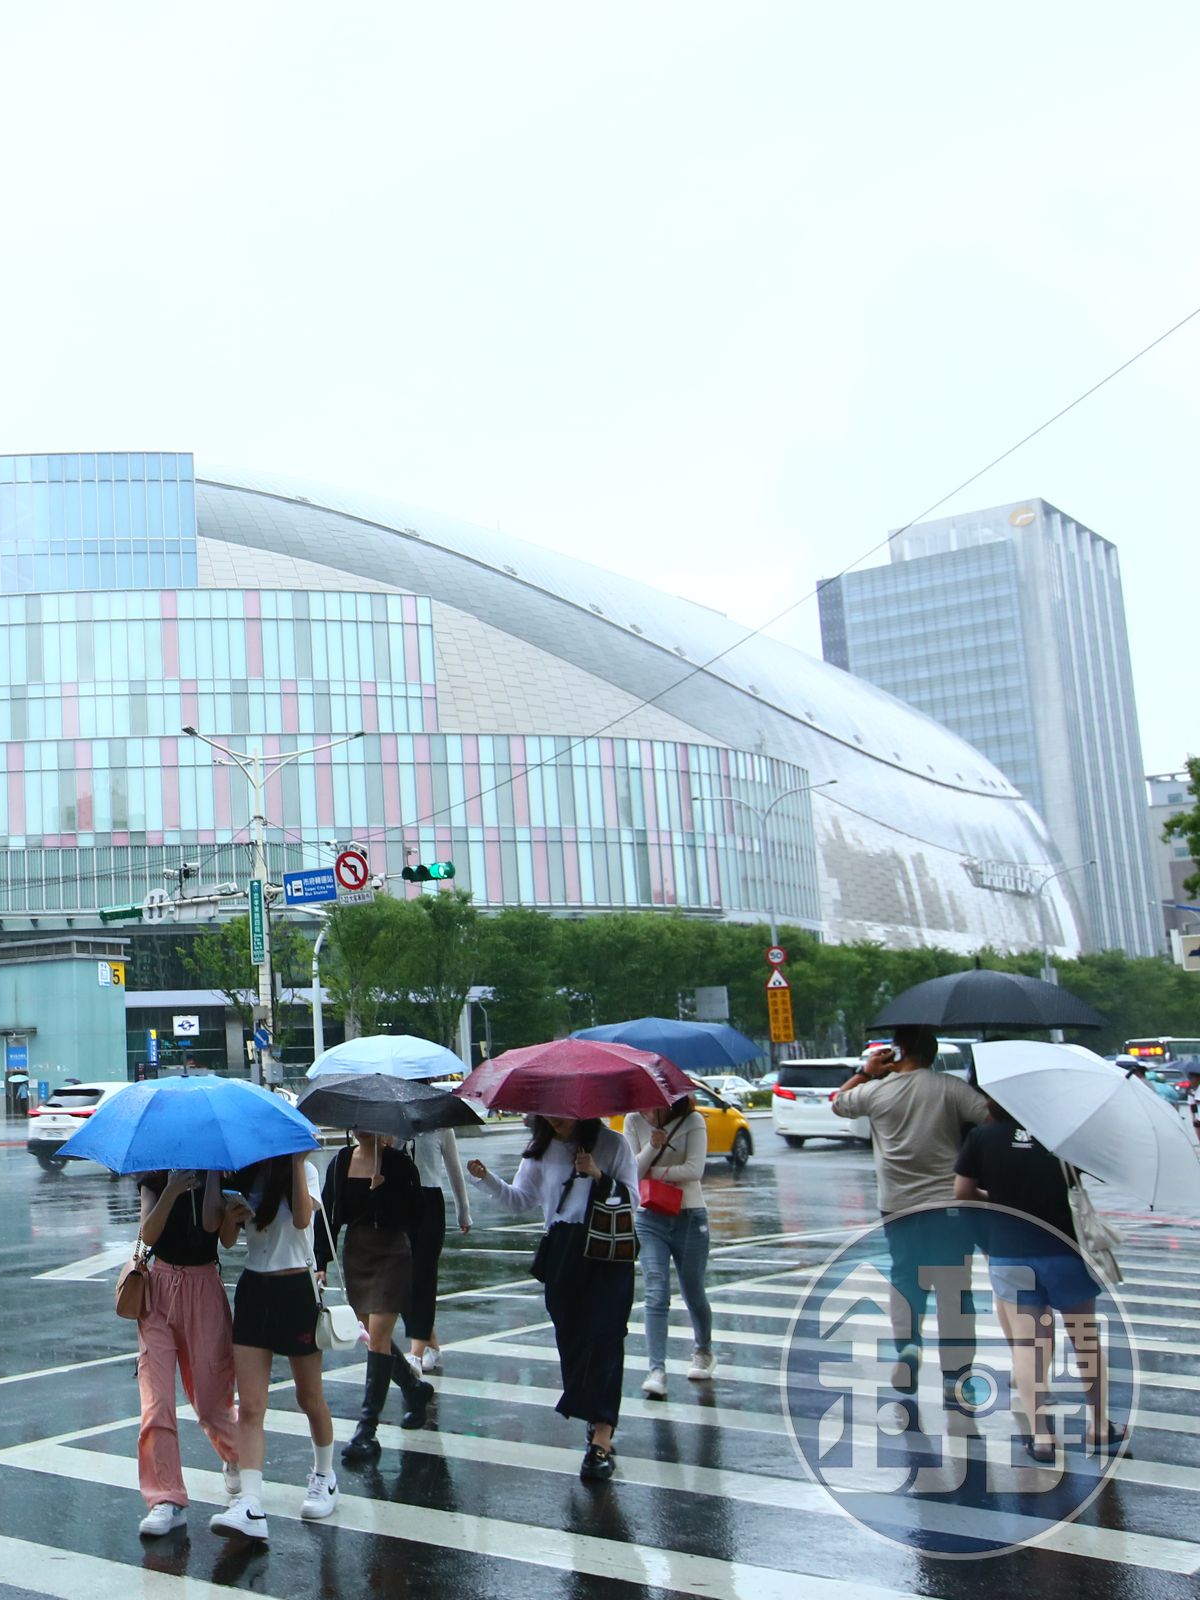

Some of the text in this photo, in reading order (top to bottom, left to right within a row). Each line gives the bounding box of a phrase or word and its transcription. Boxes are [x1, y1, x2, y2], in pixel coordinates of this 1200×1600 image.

[303, 875, 334, 885] 市府轉運站
[769, 952, 782, 960] 50
[112, 968, 121, 985] 5
